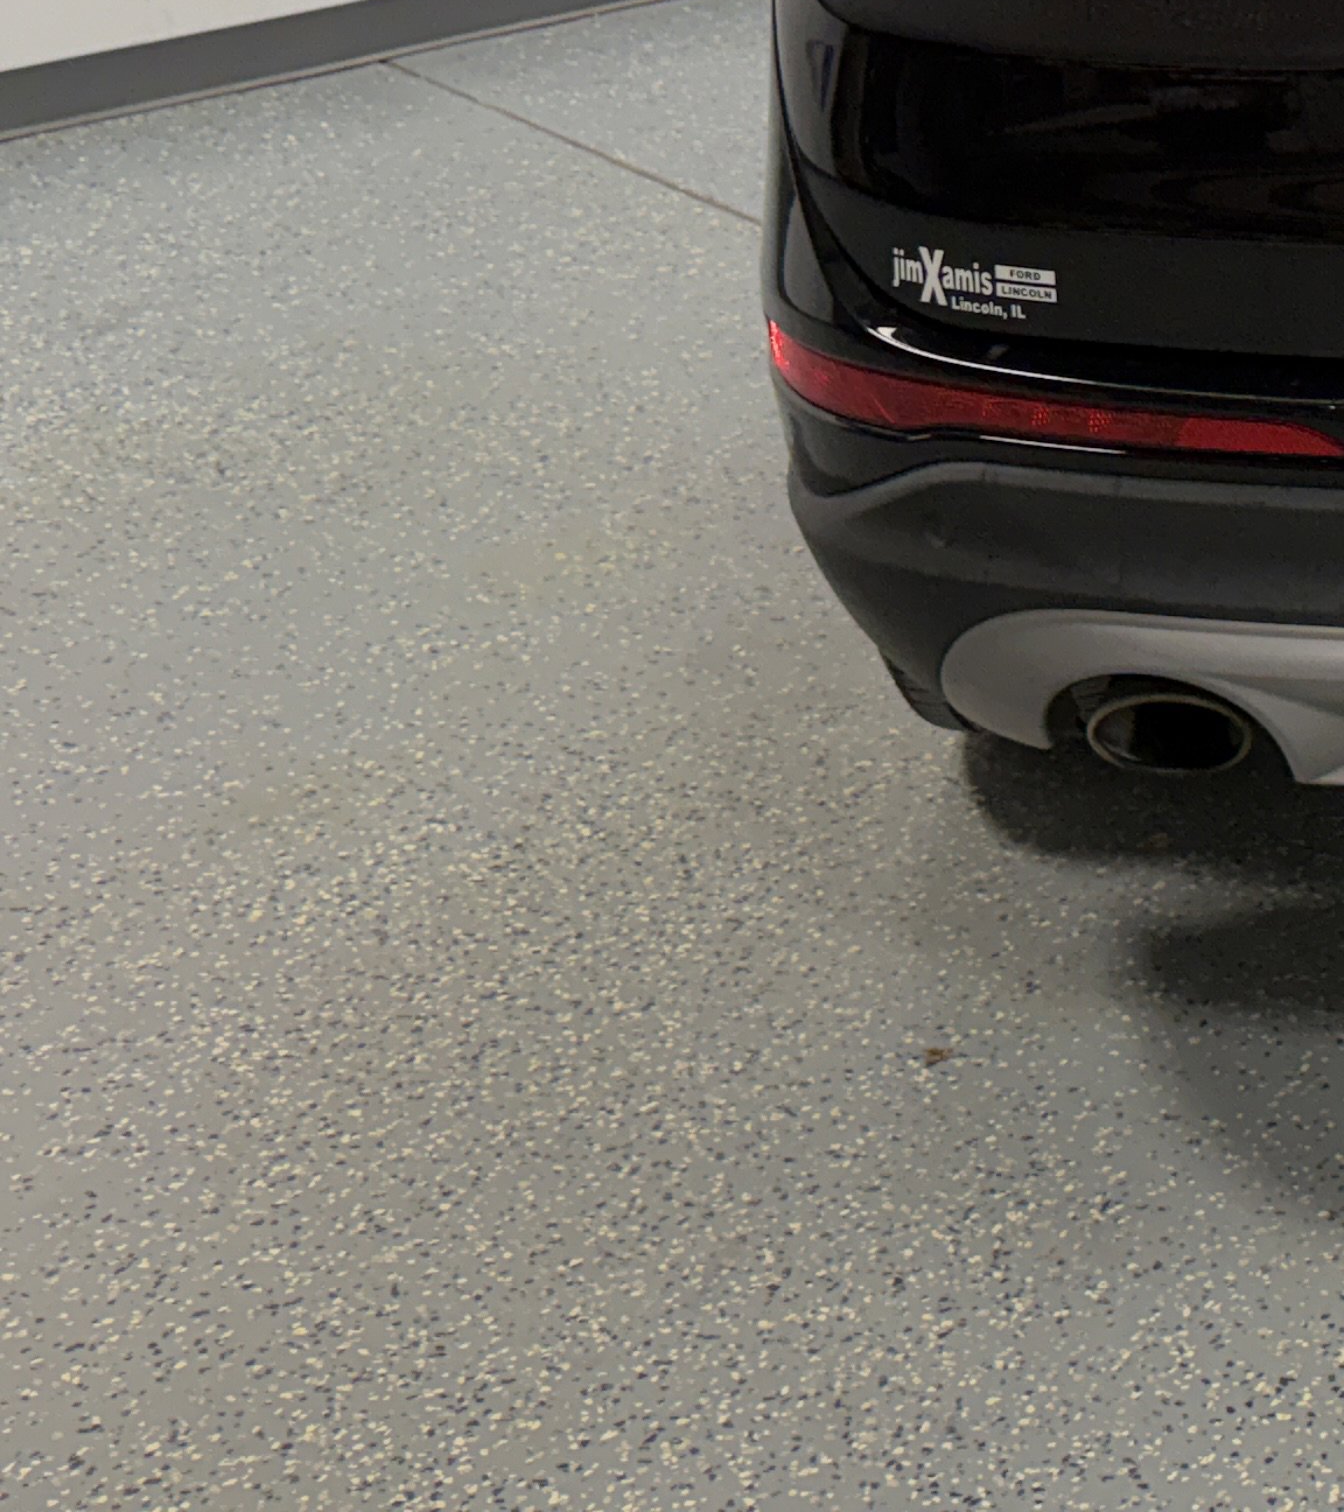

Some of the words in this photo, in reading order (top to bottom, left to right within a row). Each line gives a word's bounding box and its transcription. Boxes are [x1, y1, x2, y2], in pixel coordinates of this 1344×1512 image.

[1009, 268, 1042, 281] FORD
[1001, 285, 1053, 300] LINCOLN
[951, 295, 1009, 320] Lincoln,
[1010, 303, 1027, 320] IL
